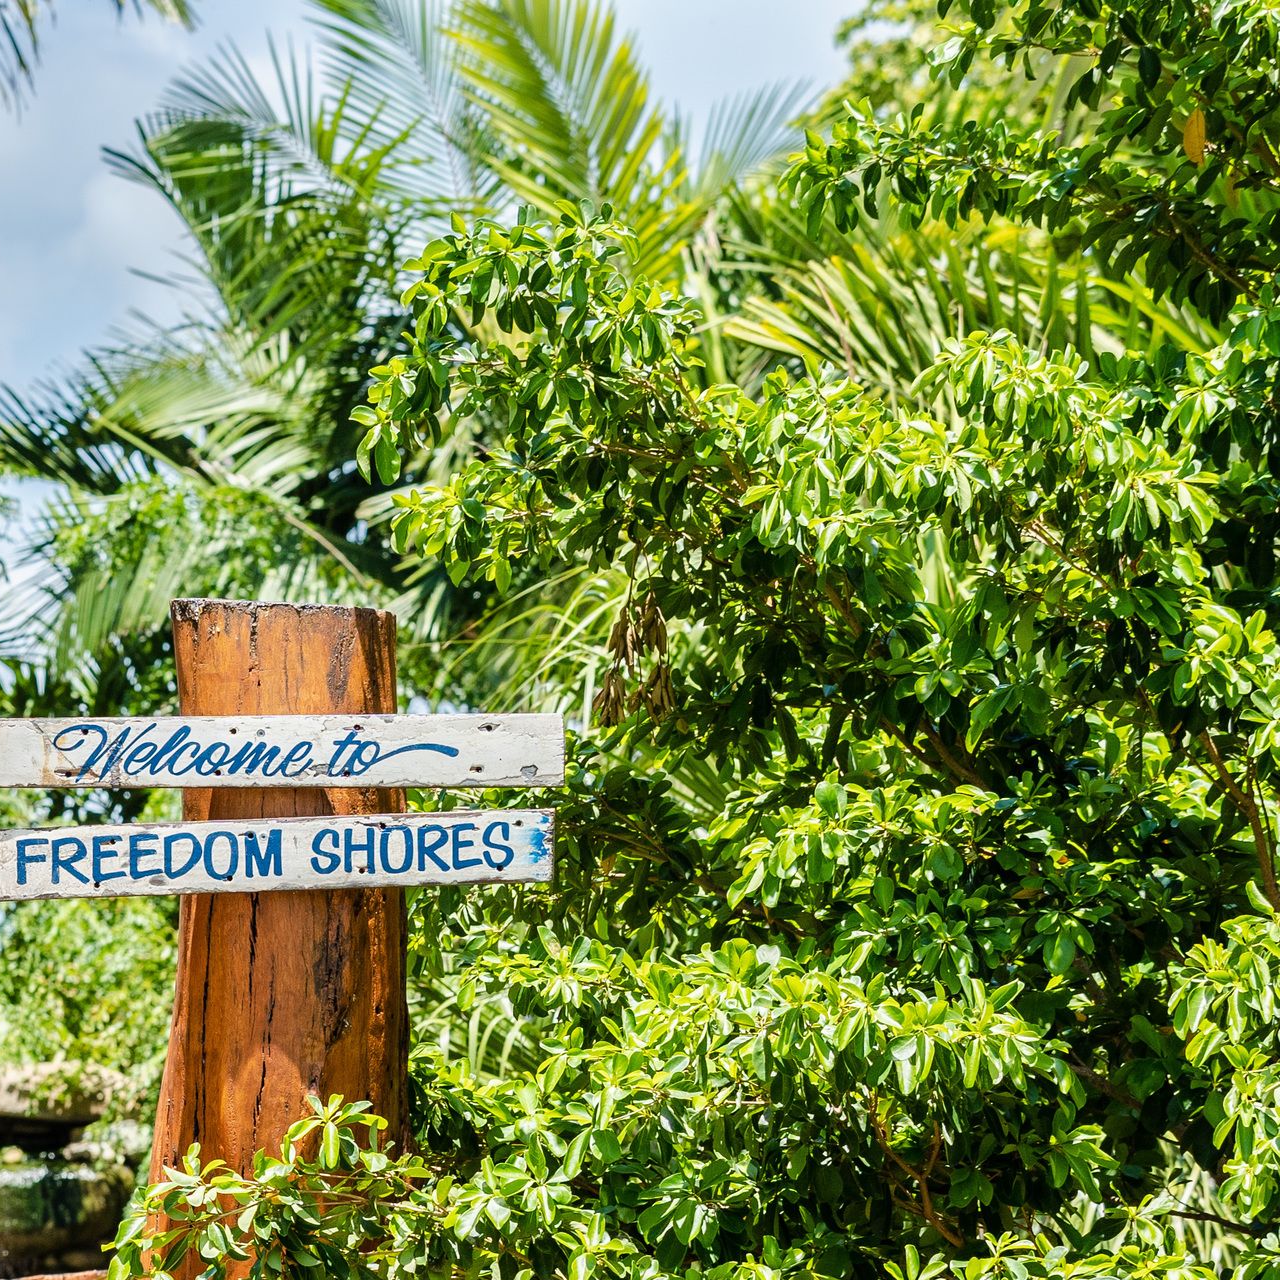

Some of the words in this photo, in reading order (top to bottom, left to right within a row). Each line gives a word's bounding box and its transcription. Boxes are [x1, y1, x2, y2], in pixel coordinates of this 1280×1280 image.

[52, 722, 314, 782] Welcome
[328, 723, 459, 778] to
[16, 829, 284, 886] FREEDOM
[311, 819, 515, 875] SHORES
